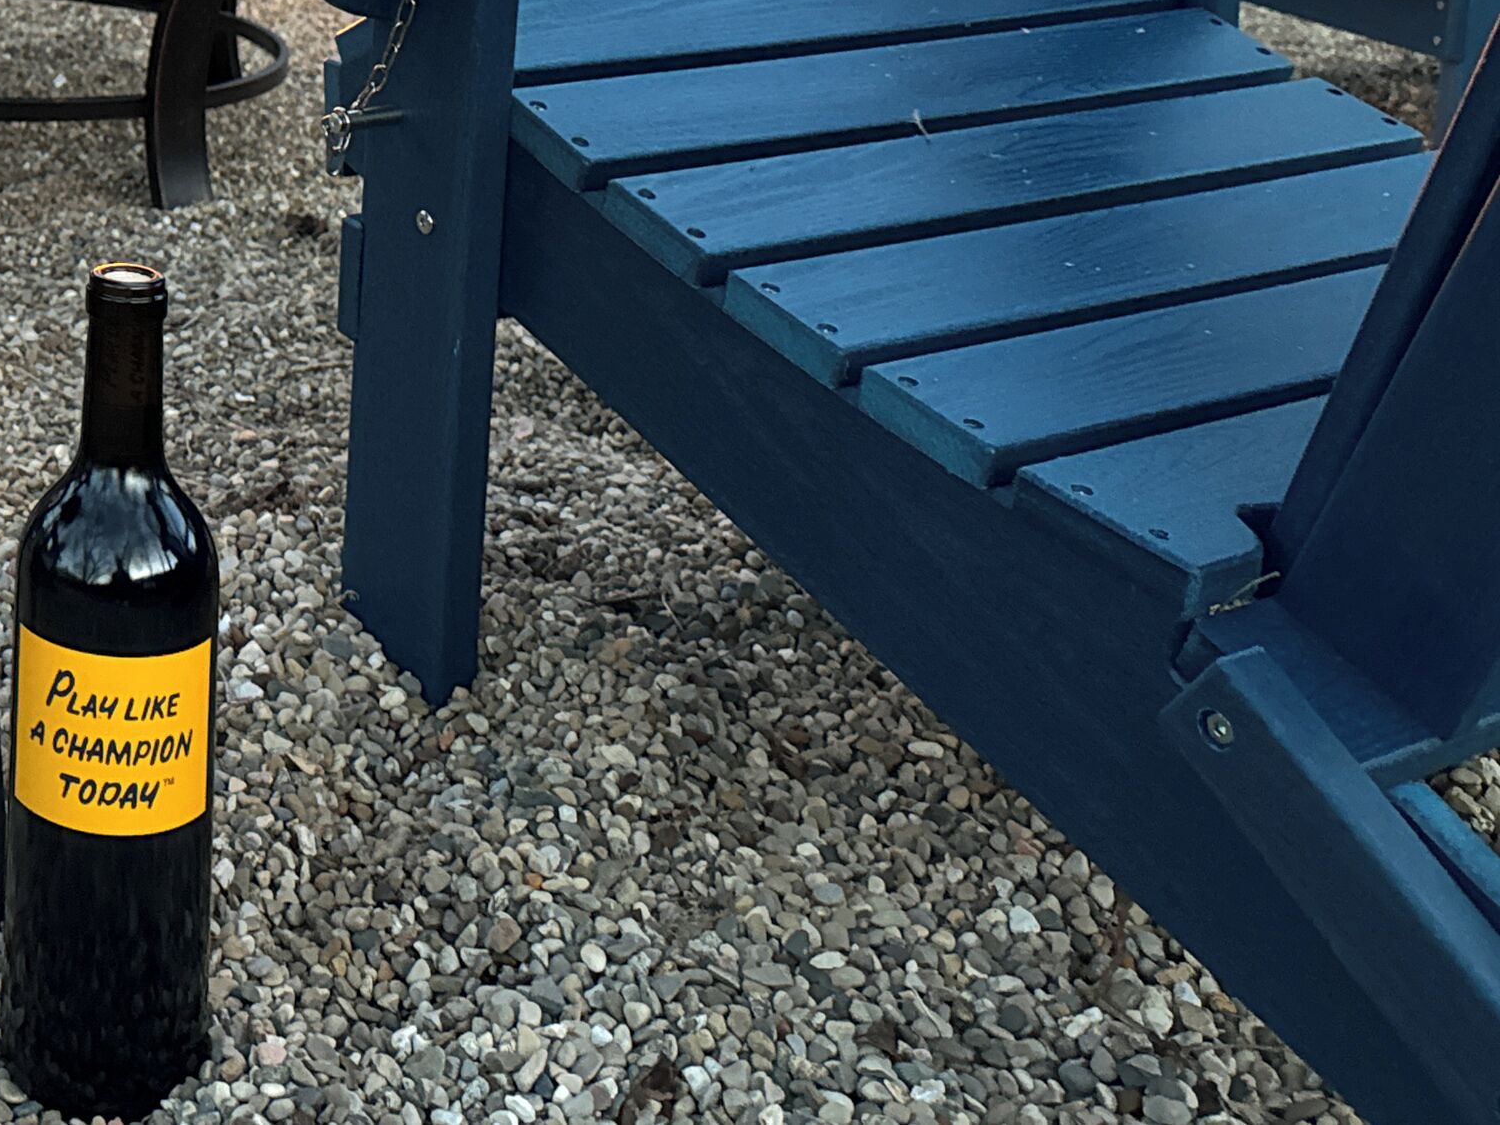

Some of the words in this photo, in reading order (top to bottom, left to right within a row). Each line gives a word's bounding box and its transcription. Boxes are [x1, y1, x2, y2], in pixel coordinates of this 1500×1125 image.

[46, 669, 119, 720] PLAY
[124, 693, 180, 721] LIKE
[30, 720, 45, 746] A
[52, 728, 193, 767] CHAMPION
